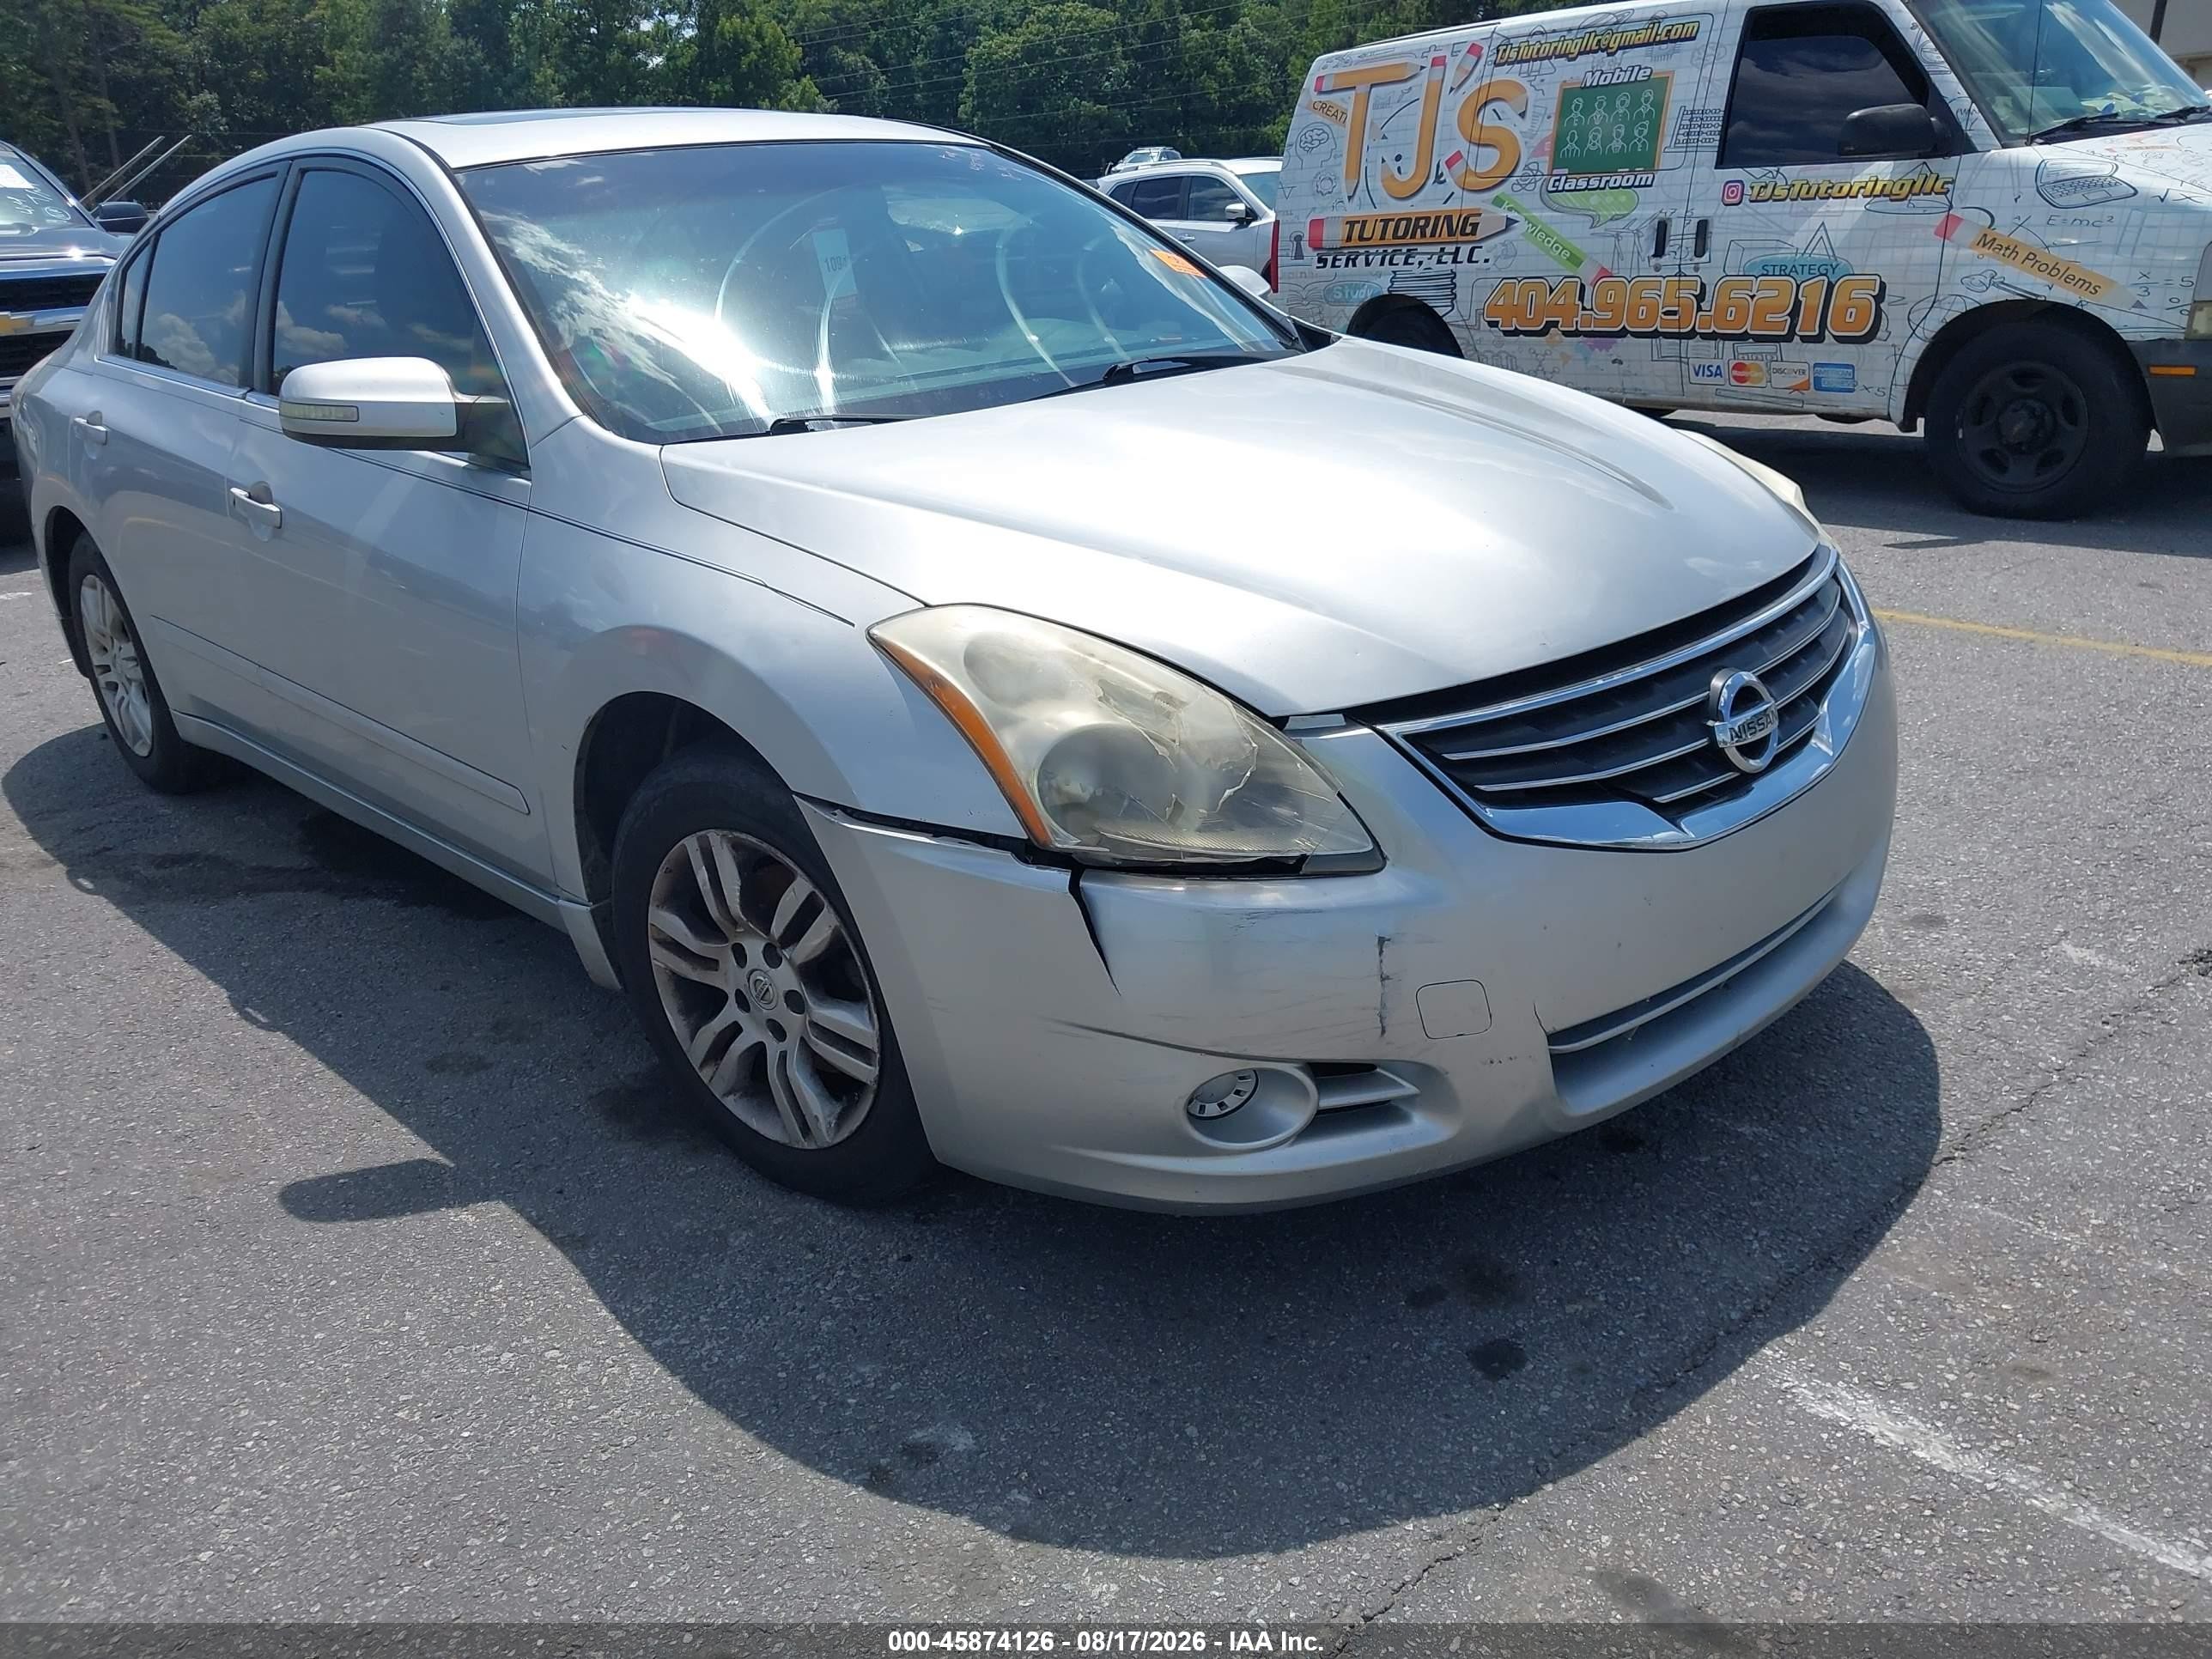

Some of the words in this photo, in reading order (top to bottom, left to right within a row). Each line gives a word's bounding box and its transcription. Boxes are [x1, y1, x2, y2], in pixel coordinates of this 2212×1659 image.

[1496, 21, 1700, 66] TJsTutoringllc@gmail.com
[1581, 65, 1653, 88] Mobile
[1547, 173, 1656, 192] Classroom
[1749, 173, 1954, 203] TJsTutoringllc
[1345, 213, 1483, 243] TUTORING
[1502, 200, 1571, 260] Kwledge
[1316, 248, 1425, 270] SERVICE,
[1436, 246, 1492, 265] LLC.
[1761, 263, 1840, 276] STRATEGY
[1976, 234, 2018, 261] Math
[2021, 252, 2102, 296] Problems
[1332, 285, 1376, 301] Study
[1484, 275, 1883, 341] 404.965.6216
[1692, 364, 1723, 379] VISA
[1772, 367, 1807, 375] DISCOVER
[1729, 709, 1778, 741] NISSAN
